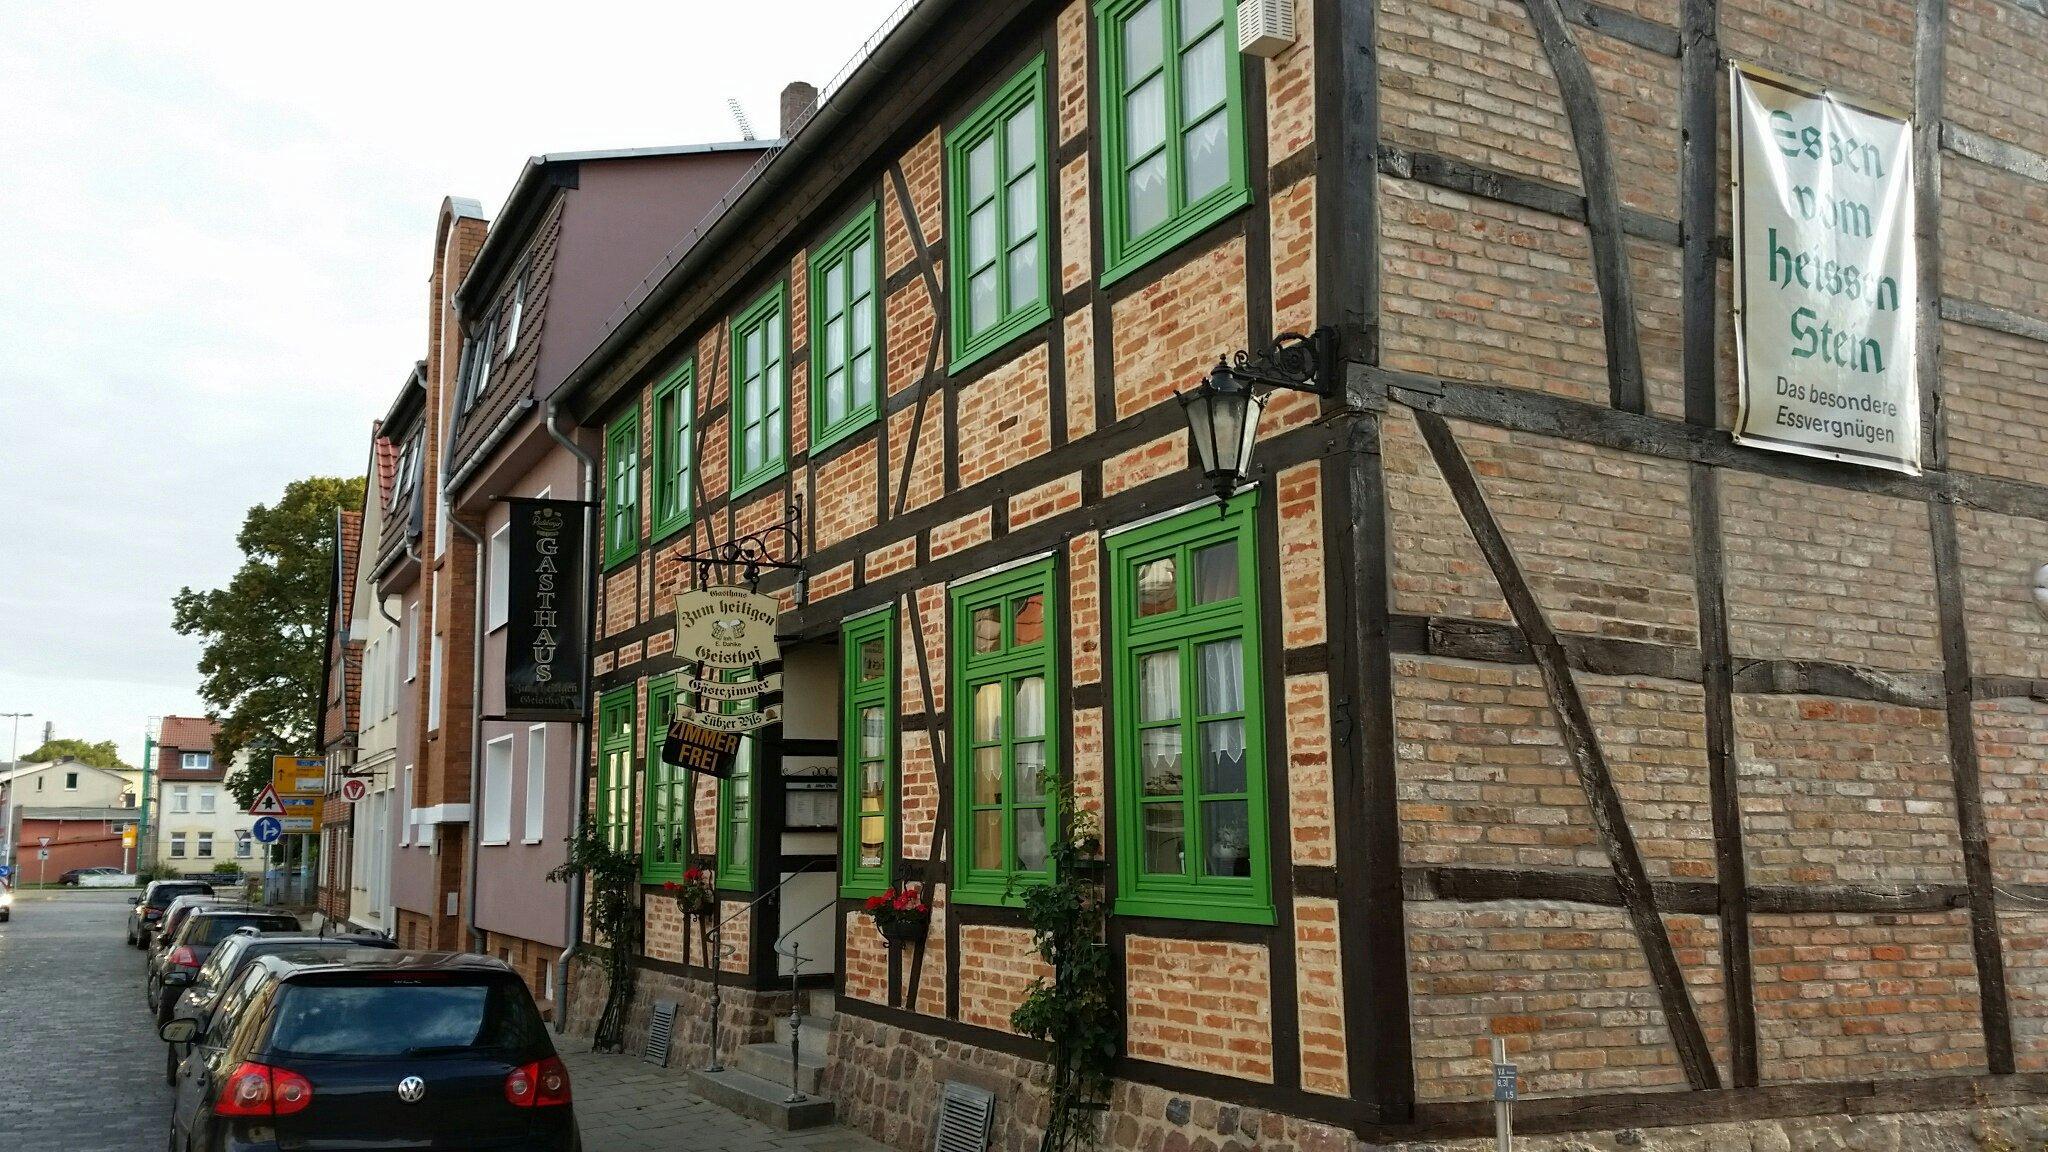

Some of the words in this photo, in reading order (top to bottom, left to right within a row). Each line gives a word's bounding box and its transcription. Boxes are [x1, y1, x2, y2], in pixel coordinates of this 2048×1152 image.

[1770, 109, 1885, 179] Essen
[1792, 185, 1872, 239] vom
[1768, 228, 1899, 311] heissen
[1791, 306, 1885, 374] Stein
[1776, 376, 1806, 400] Das
[1809, 384, 1897, 417] besondere
[1776, 405, 1894, 443] Essvergnügen
[533, 538, 558, 682] GASTHAUS
[709, 589, 748, 599] Gasthaus
[682, 604, 715, 628] Zum
[720, 600, 775, 625] heiligen
[695, 646, 762, 664] Geisthof
[688, 679, 769, 699] Gästezimmer
[669, 721, 739, 755] ZIMMER
[701, 715, 736, 730] Lübzer
[738, 713, 762, 727] Pils
[679, 743, 719, 772] FREI
